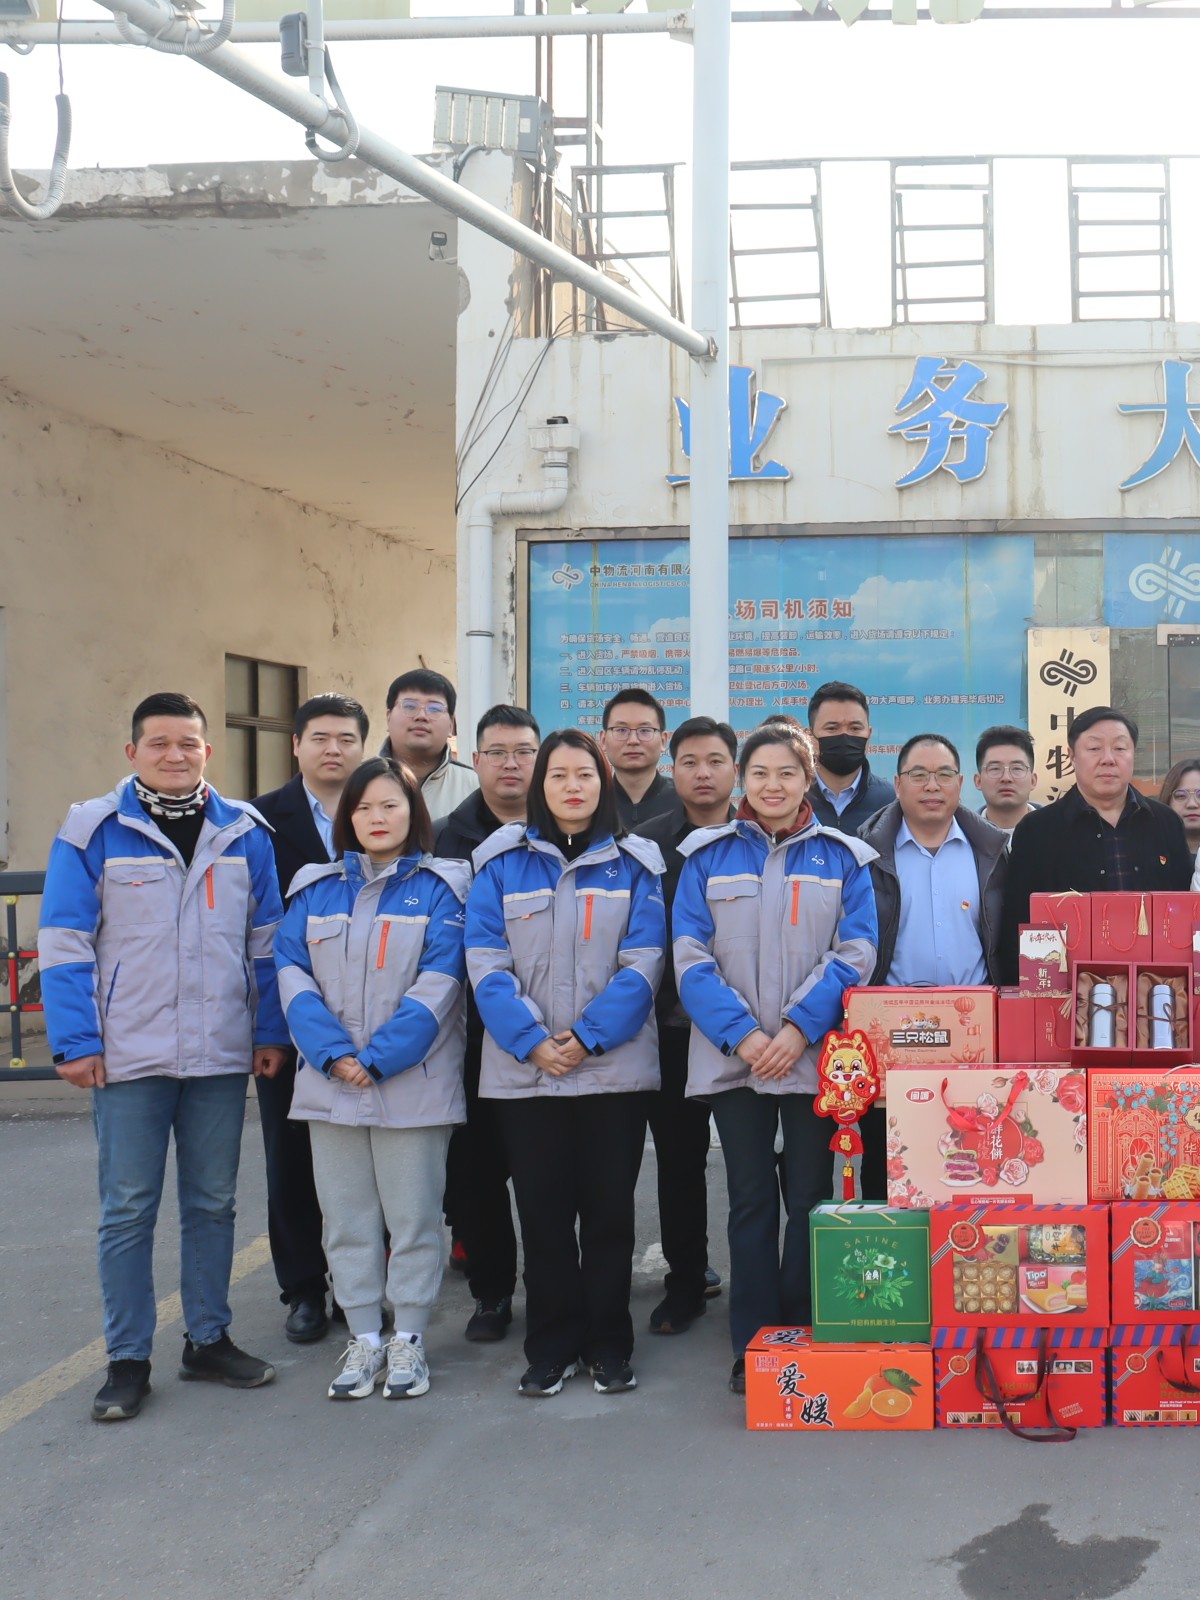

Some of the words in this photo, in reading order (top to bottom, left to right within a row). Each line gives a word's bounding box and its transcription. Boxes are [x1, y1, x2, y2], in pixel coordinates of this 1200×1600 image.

[728, 599, 854, 620] 场司机须知
[892, 1030, 949, 1044] 三只松鼠
[838, 1134, 853, 1152] 福
[844, 1235, 898, 1249] SATINE
[865, 1269, 879, 1281] 金典
[1025, 1269, 1047, 1281] Tipo
[776, 1362, 835, 1429] 爱媛
